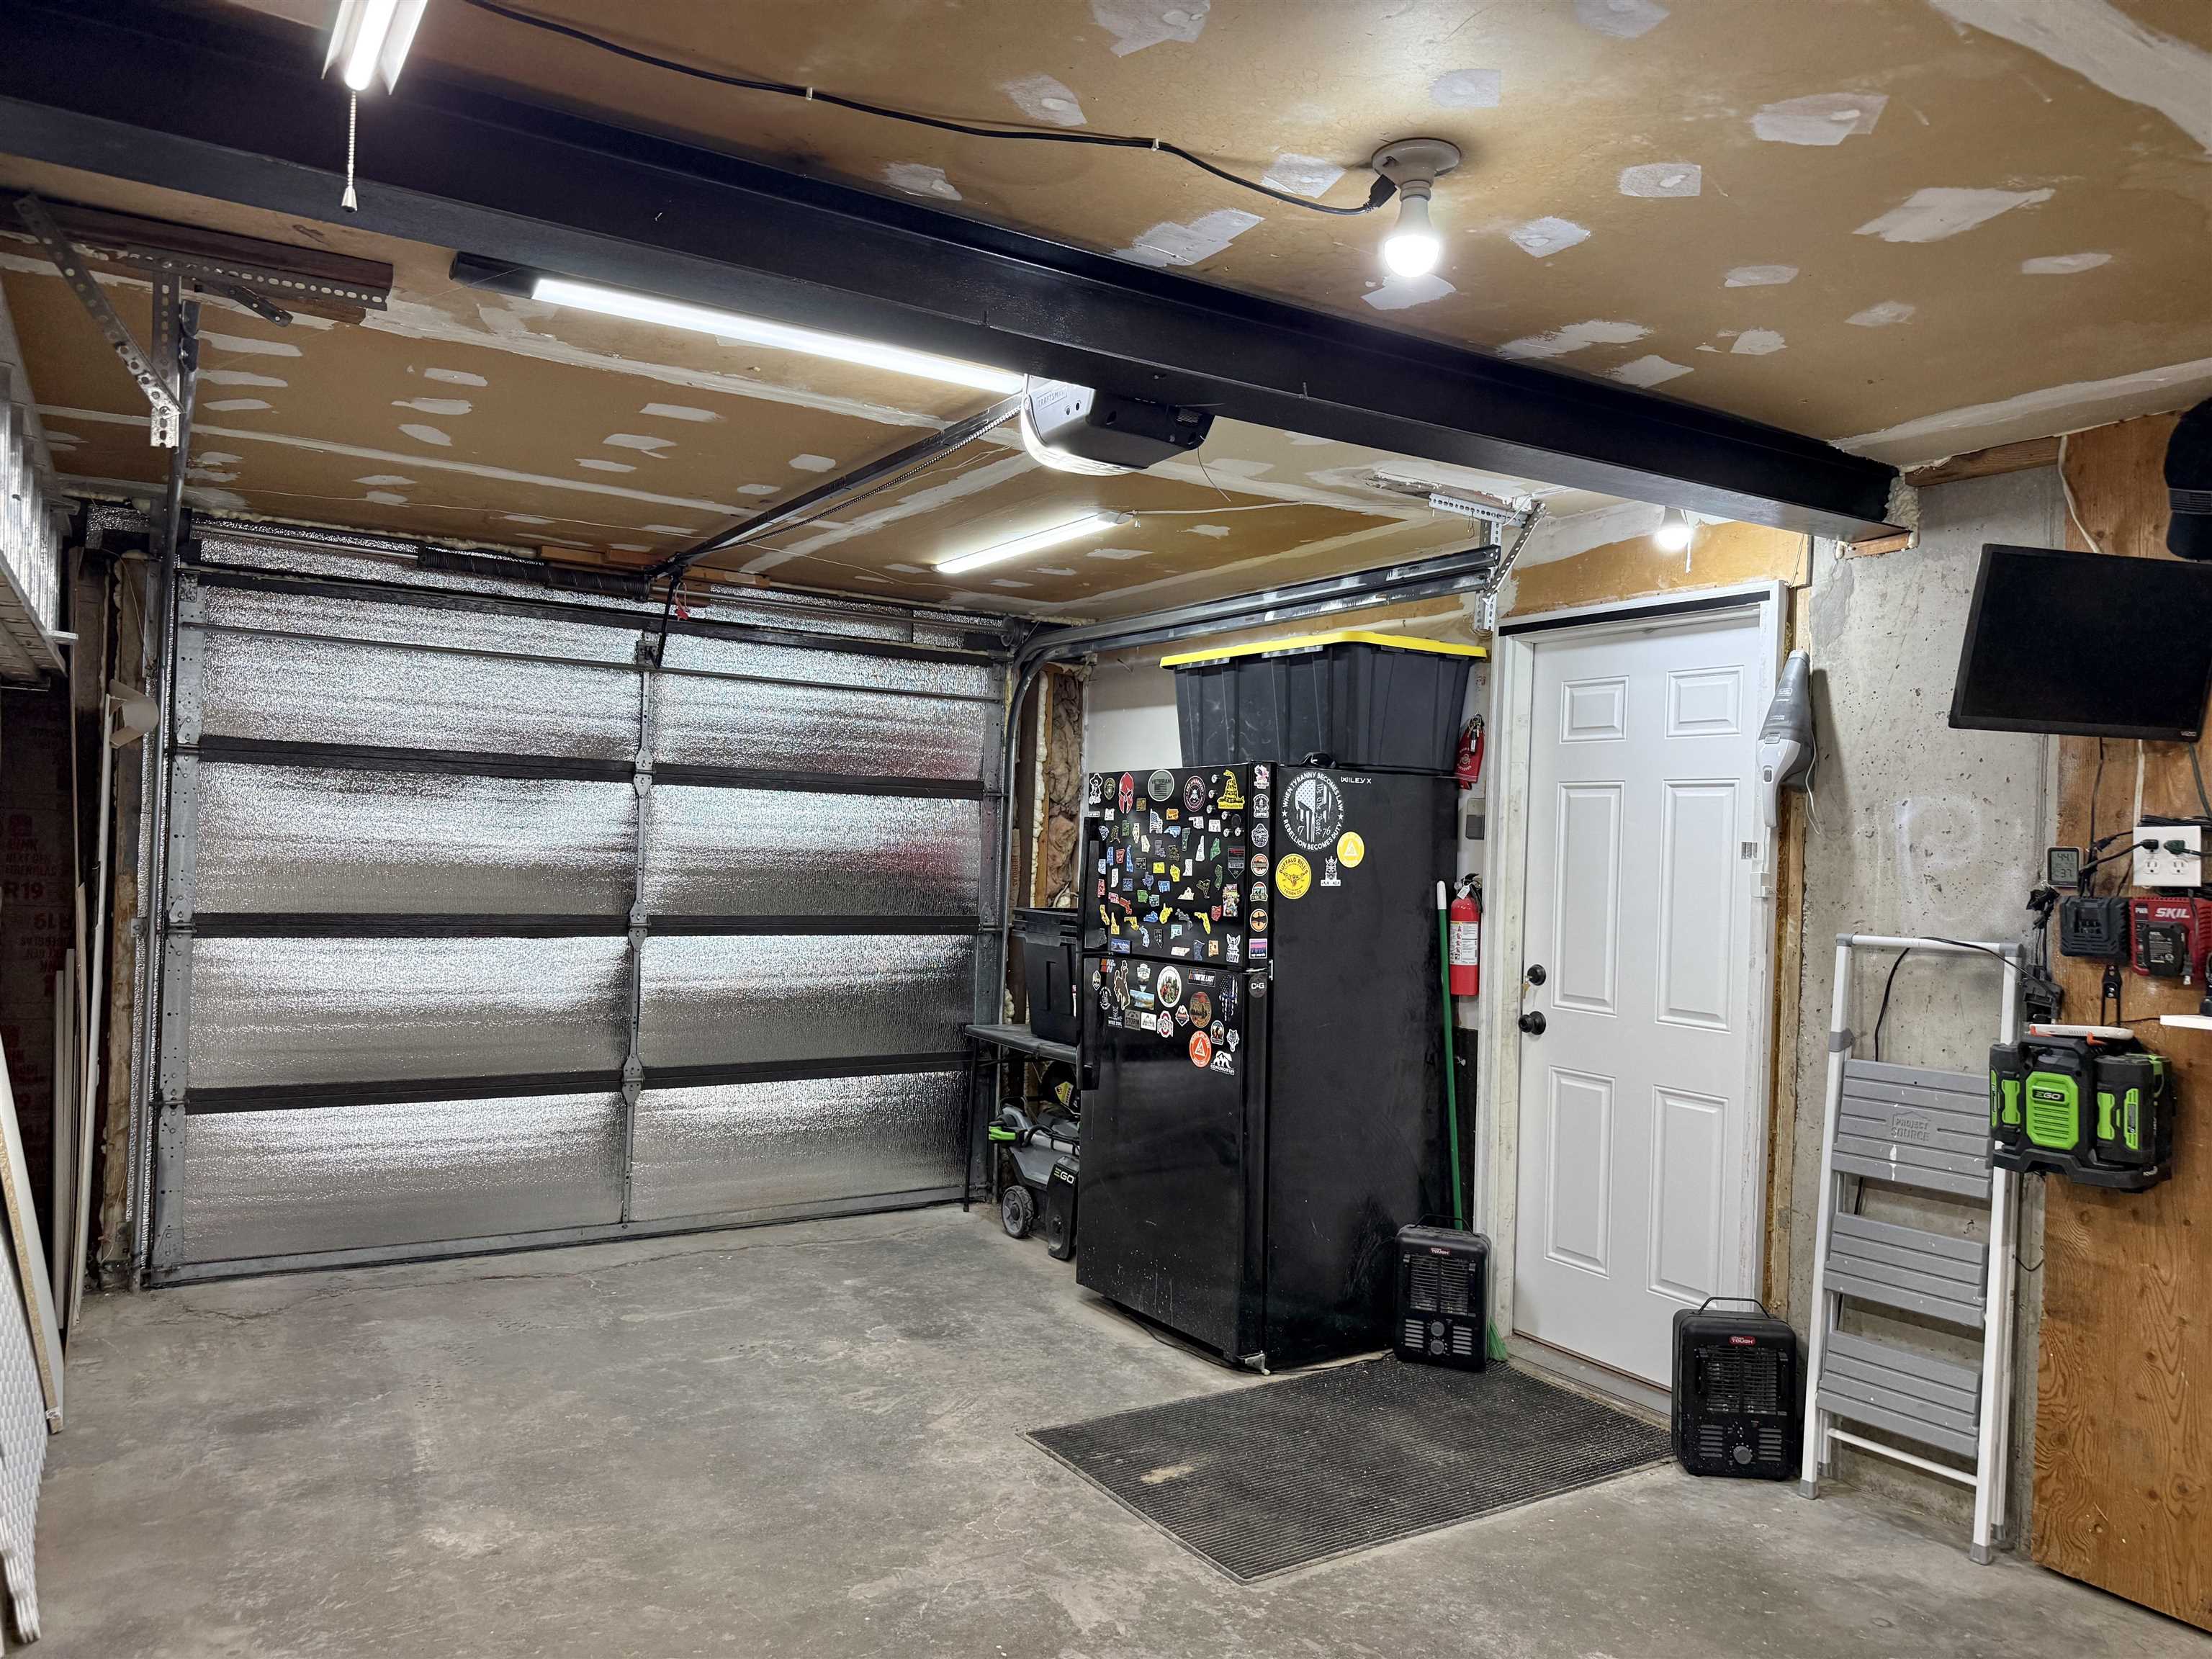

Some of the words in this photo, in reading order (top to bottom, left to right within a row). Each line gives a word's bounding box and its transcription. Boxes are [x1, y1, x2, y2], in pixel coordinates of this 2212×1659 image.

[1282, 786, 1293, 808] WHEN
[1291, 771, 1317, 788] TYRANNY
[1317, 772, 1339, 795] BECOMES
[1283, 819, 1307, 849] REBELLION
[1307, 837, 1334, 850] BECOMES
[1331, 821, 1342, 840] DUTY
[1279, 857, 1297, 874] BUFFALO
[2154, 907, 2190, 920] SKIL
[1226, 953, 1239, 963] NAVY
[1125, 1017, 1140, 1027] STORM
[2035, 1090, 2063, 1100] EGO
[1895, 1118, 1929, 1130] PROJECT
[1891, 1127, 1930, 1141] SOURCE
[1053, 1166, 1075, 1185] EGO
